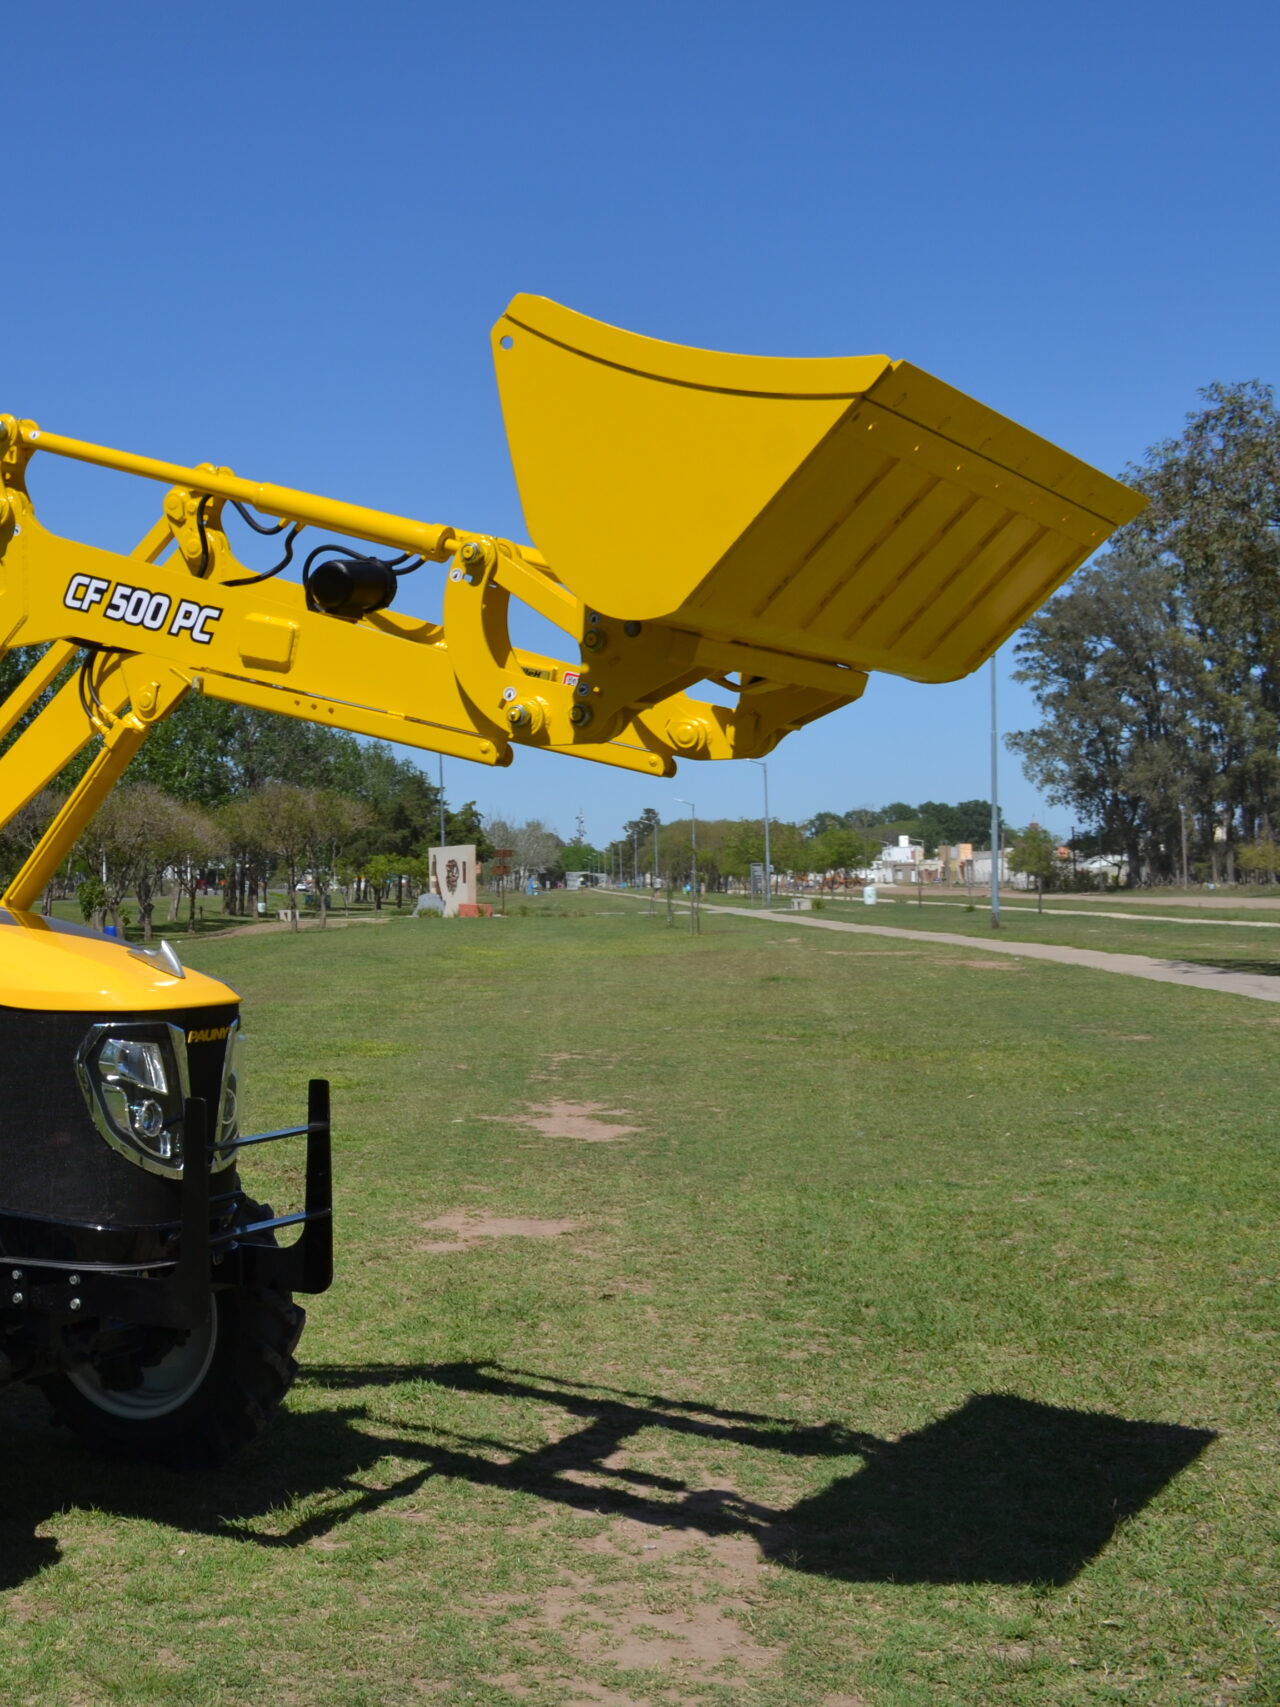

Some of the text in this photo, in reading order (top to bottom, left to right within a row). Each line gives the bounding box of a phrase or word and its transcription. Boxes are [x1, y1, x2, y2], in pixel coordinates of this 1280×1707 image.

[63, 572, 224, 645] CF 500 PC
